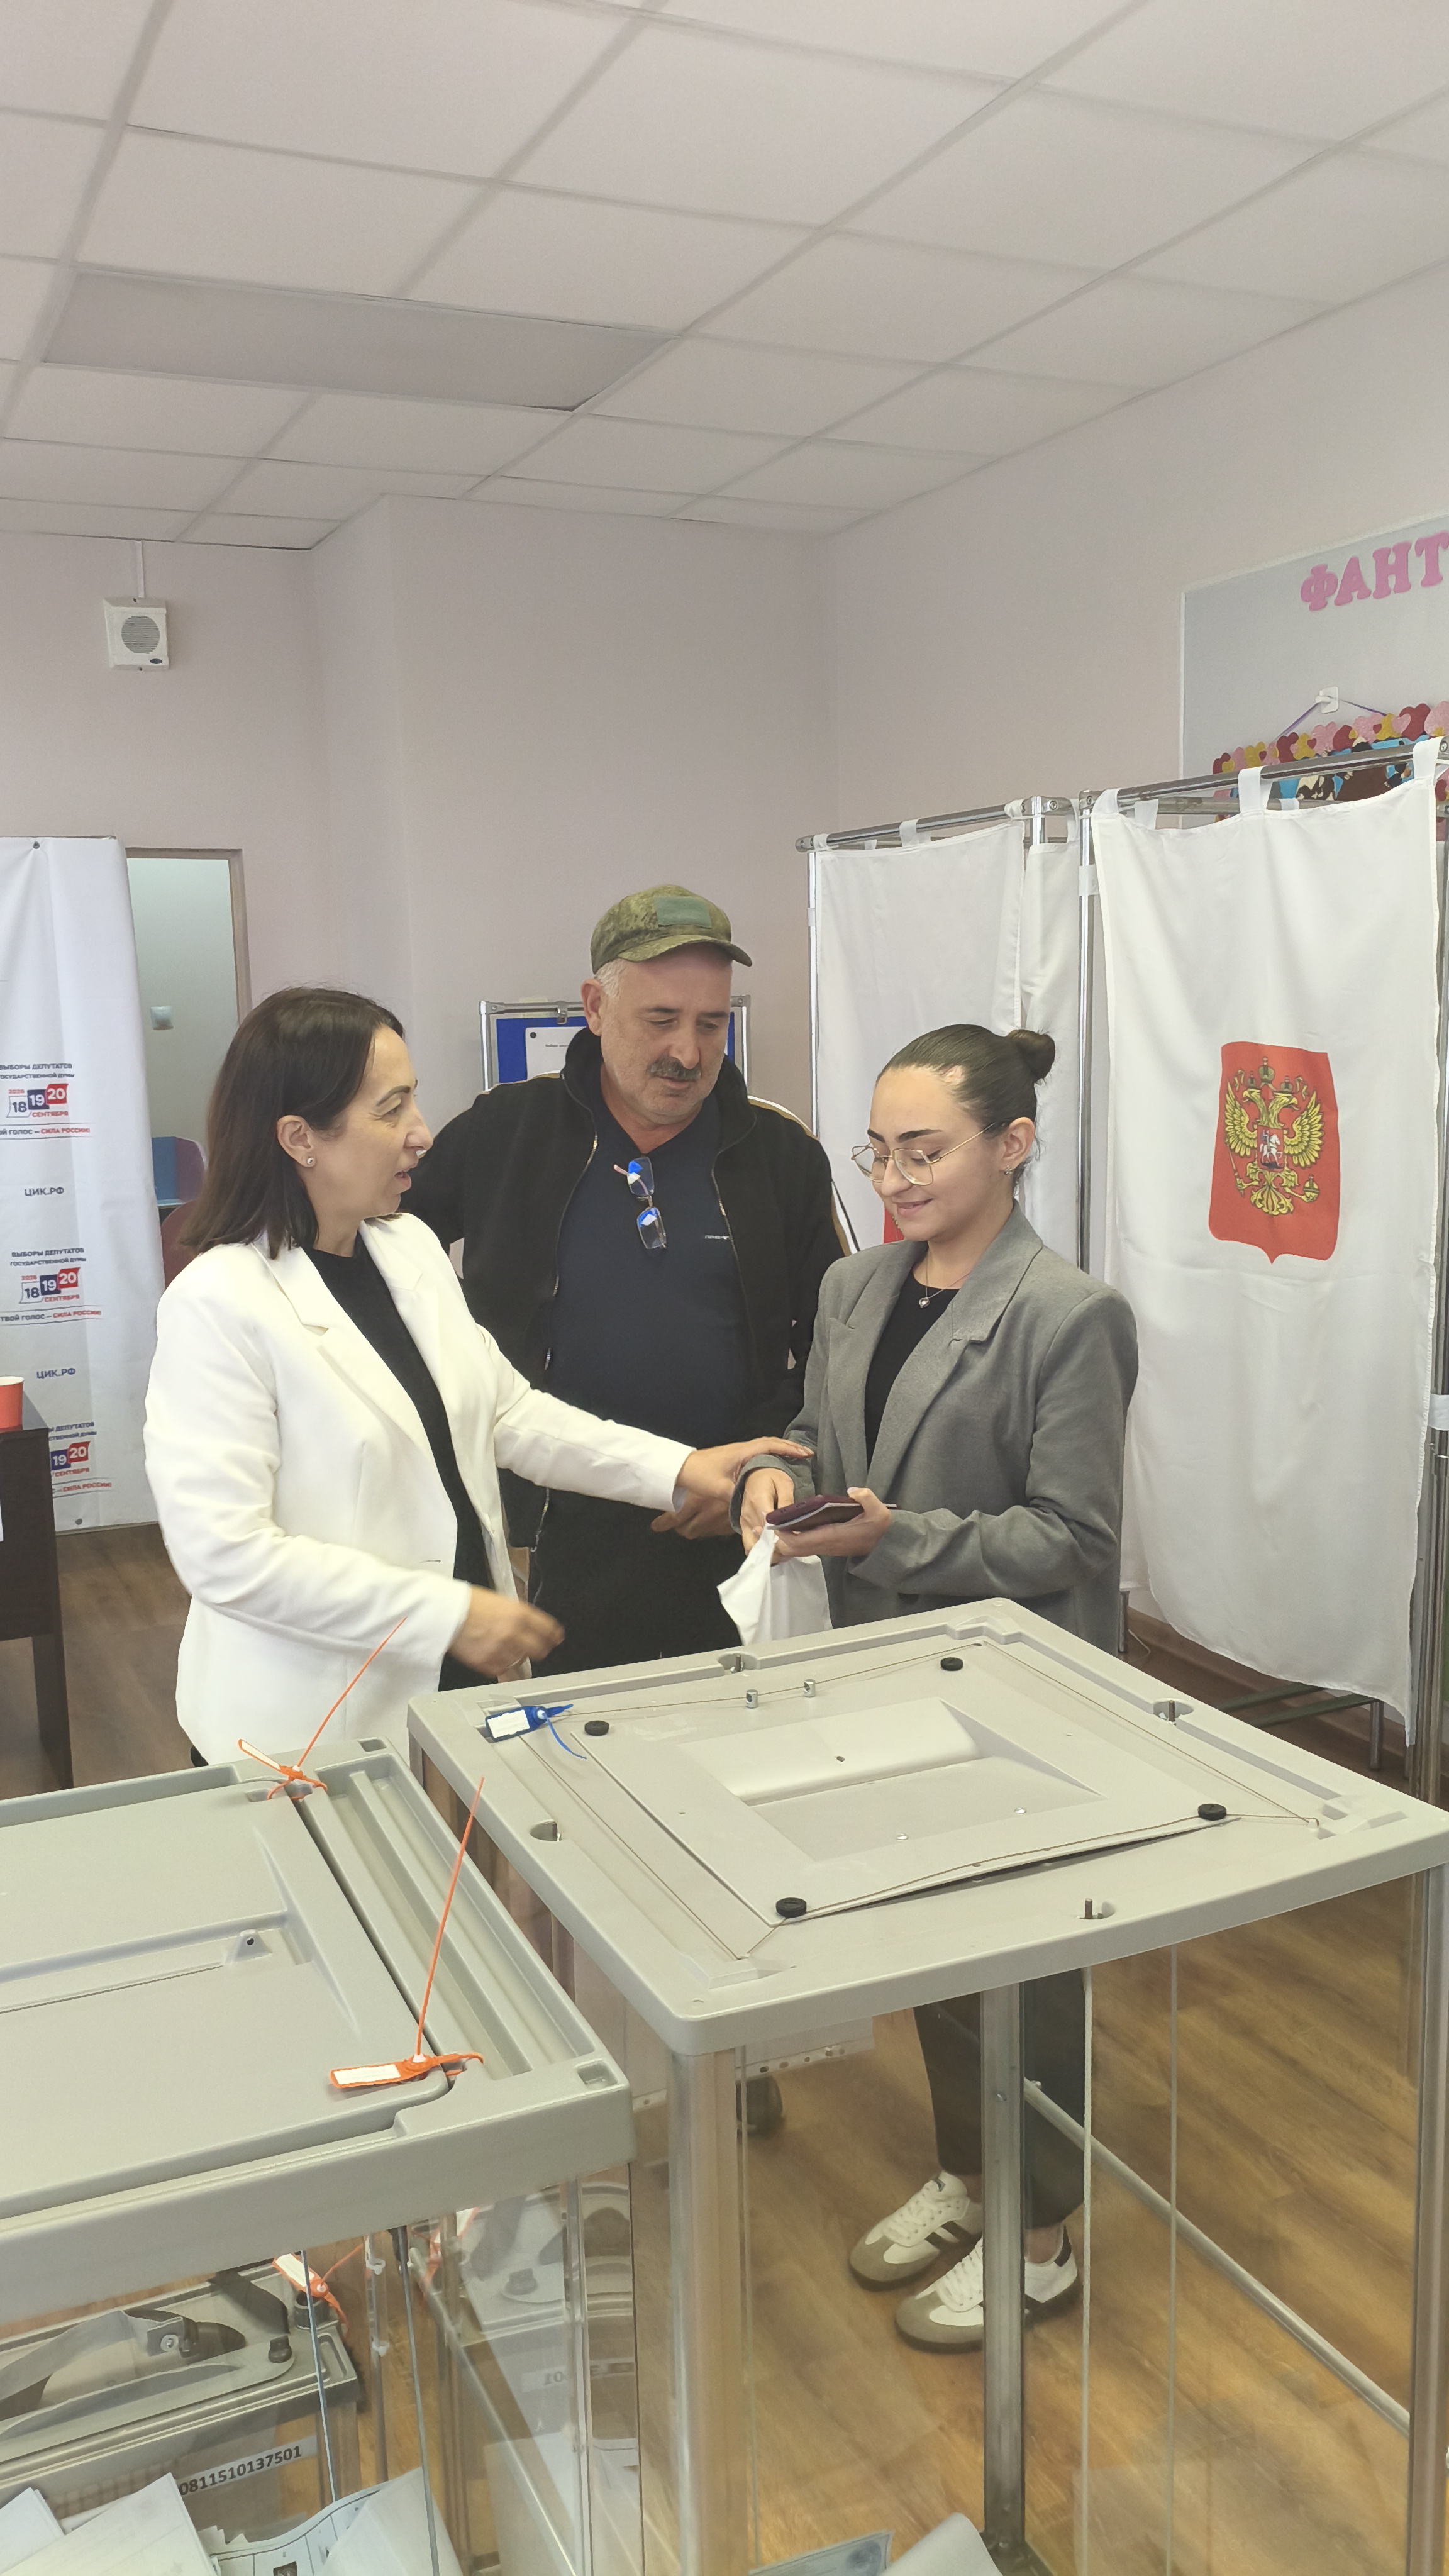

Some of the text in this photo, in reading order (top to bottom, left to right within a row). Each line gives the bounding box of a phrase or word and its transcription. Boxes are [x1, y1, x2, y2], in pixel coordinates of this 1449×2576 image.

[1301, 530, 1449, 611] ФАНТ
[13, 1088, 65, 1113] 18 19 20
[25, 1187, 65, 1197] ЦИК.РФ
[45, 1248, 84, 1257] ДЕПУТАТОВ
[25, 1272, 77, 1299] 18 19 20
[36, 1367, 76, 1379] ЦИК.РФ
[53, 1446, 87, 1466] 19 20
[179, 2446, 302, 2496] 0811510137501
